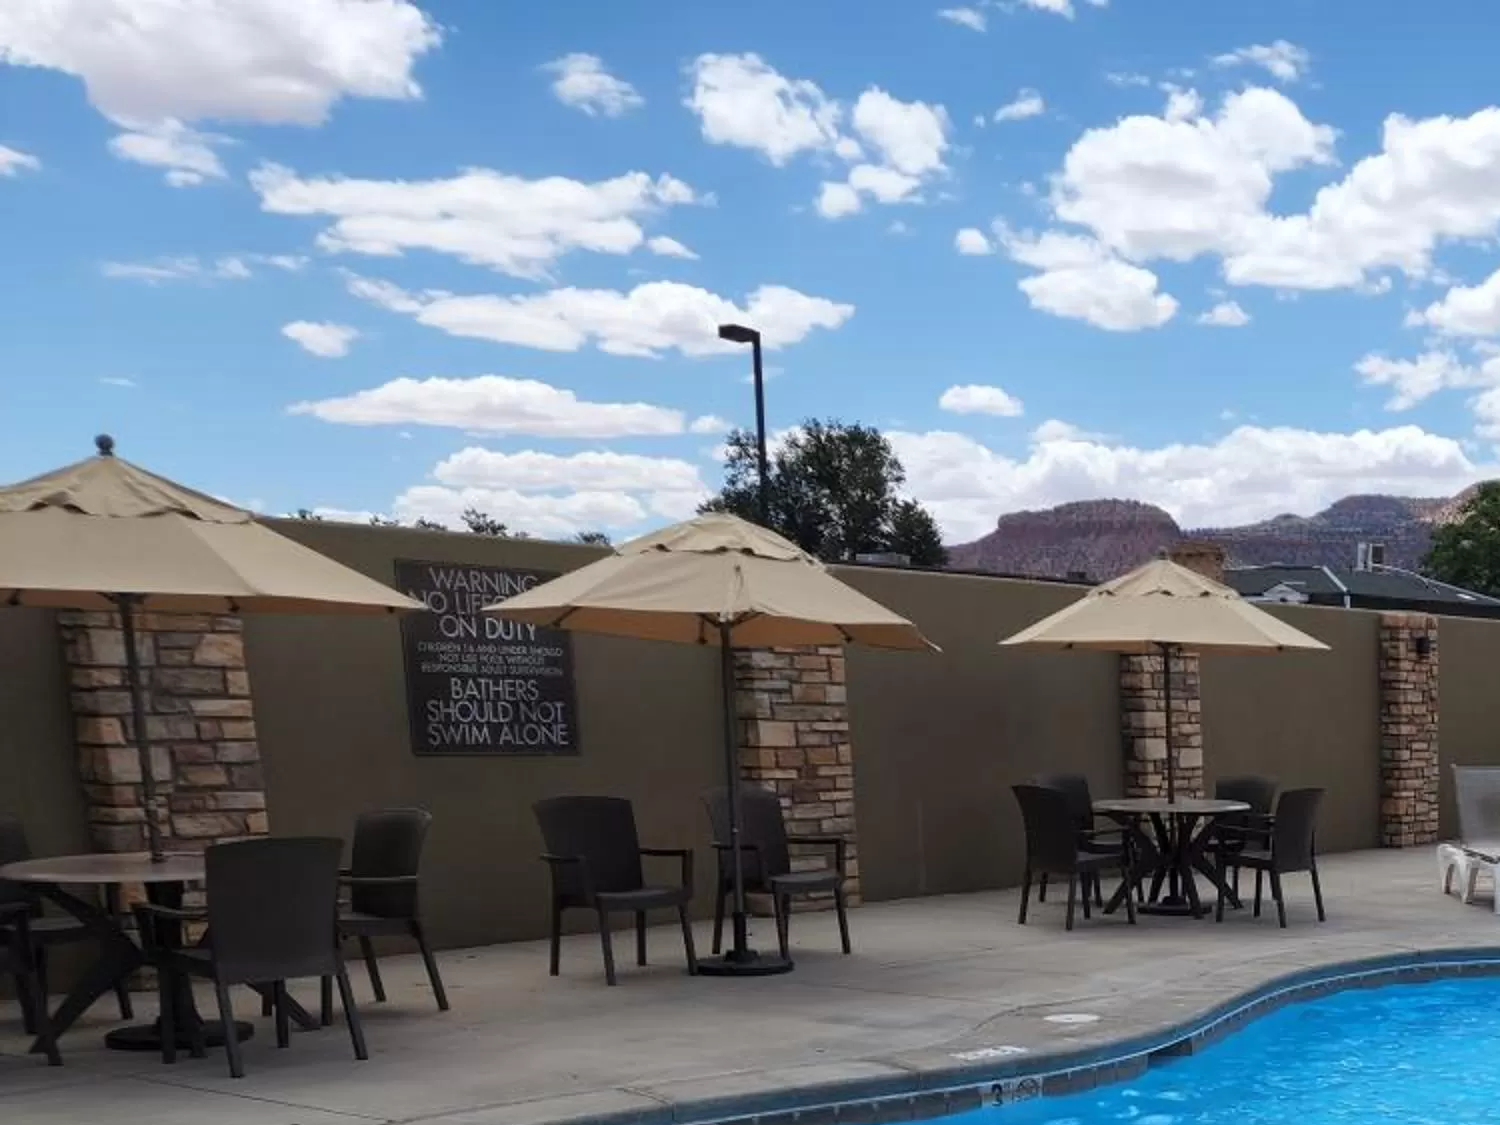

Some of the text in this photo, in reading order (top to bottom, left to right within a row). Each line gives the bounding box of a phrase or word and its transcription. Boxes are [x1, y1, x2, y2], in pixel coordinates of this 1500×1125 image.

[440, 615, 536, 641] ON DUTY
[451, 677, 539, 701] BATHERS
[427, 700, 565, 723] SHOULD NOT
[428, 723, 568, 746] SWIM ALONE
